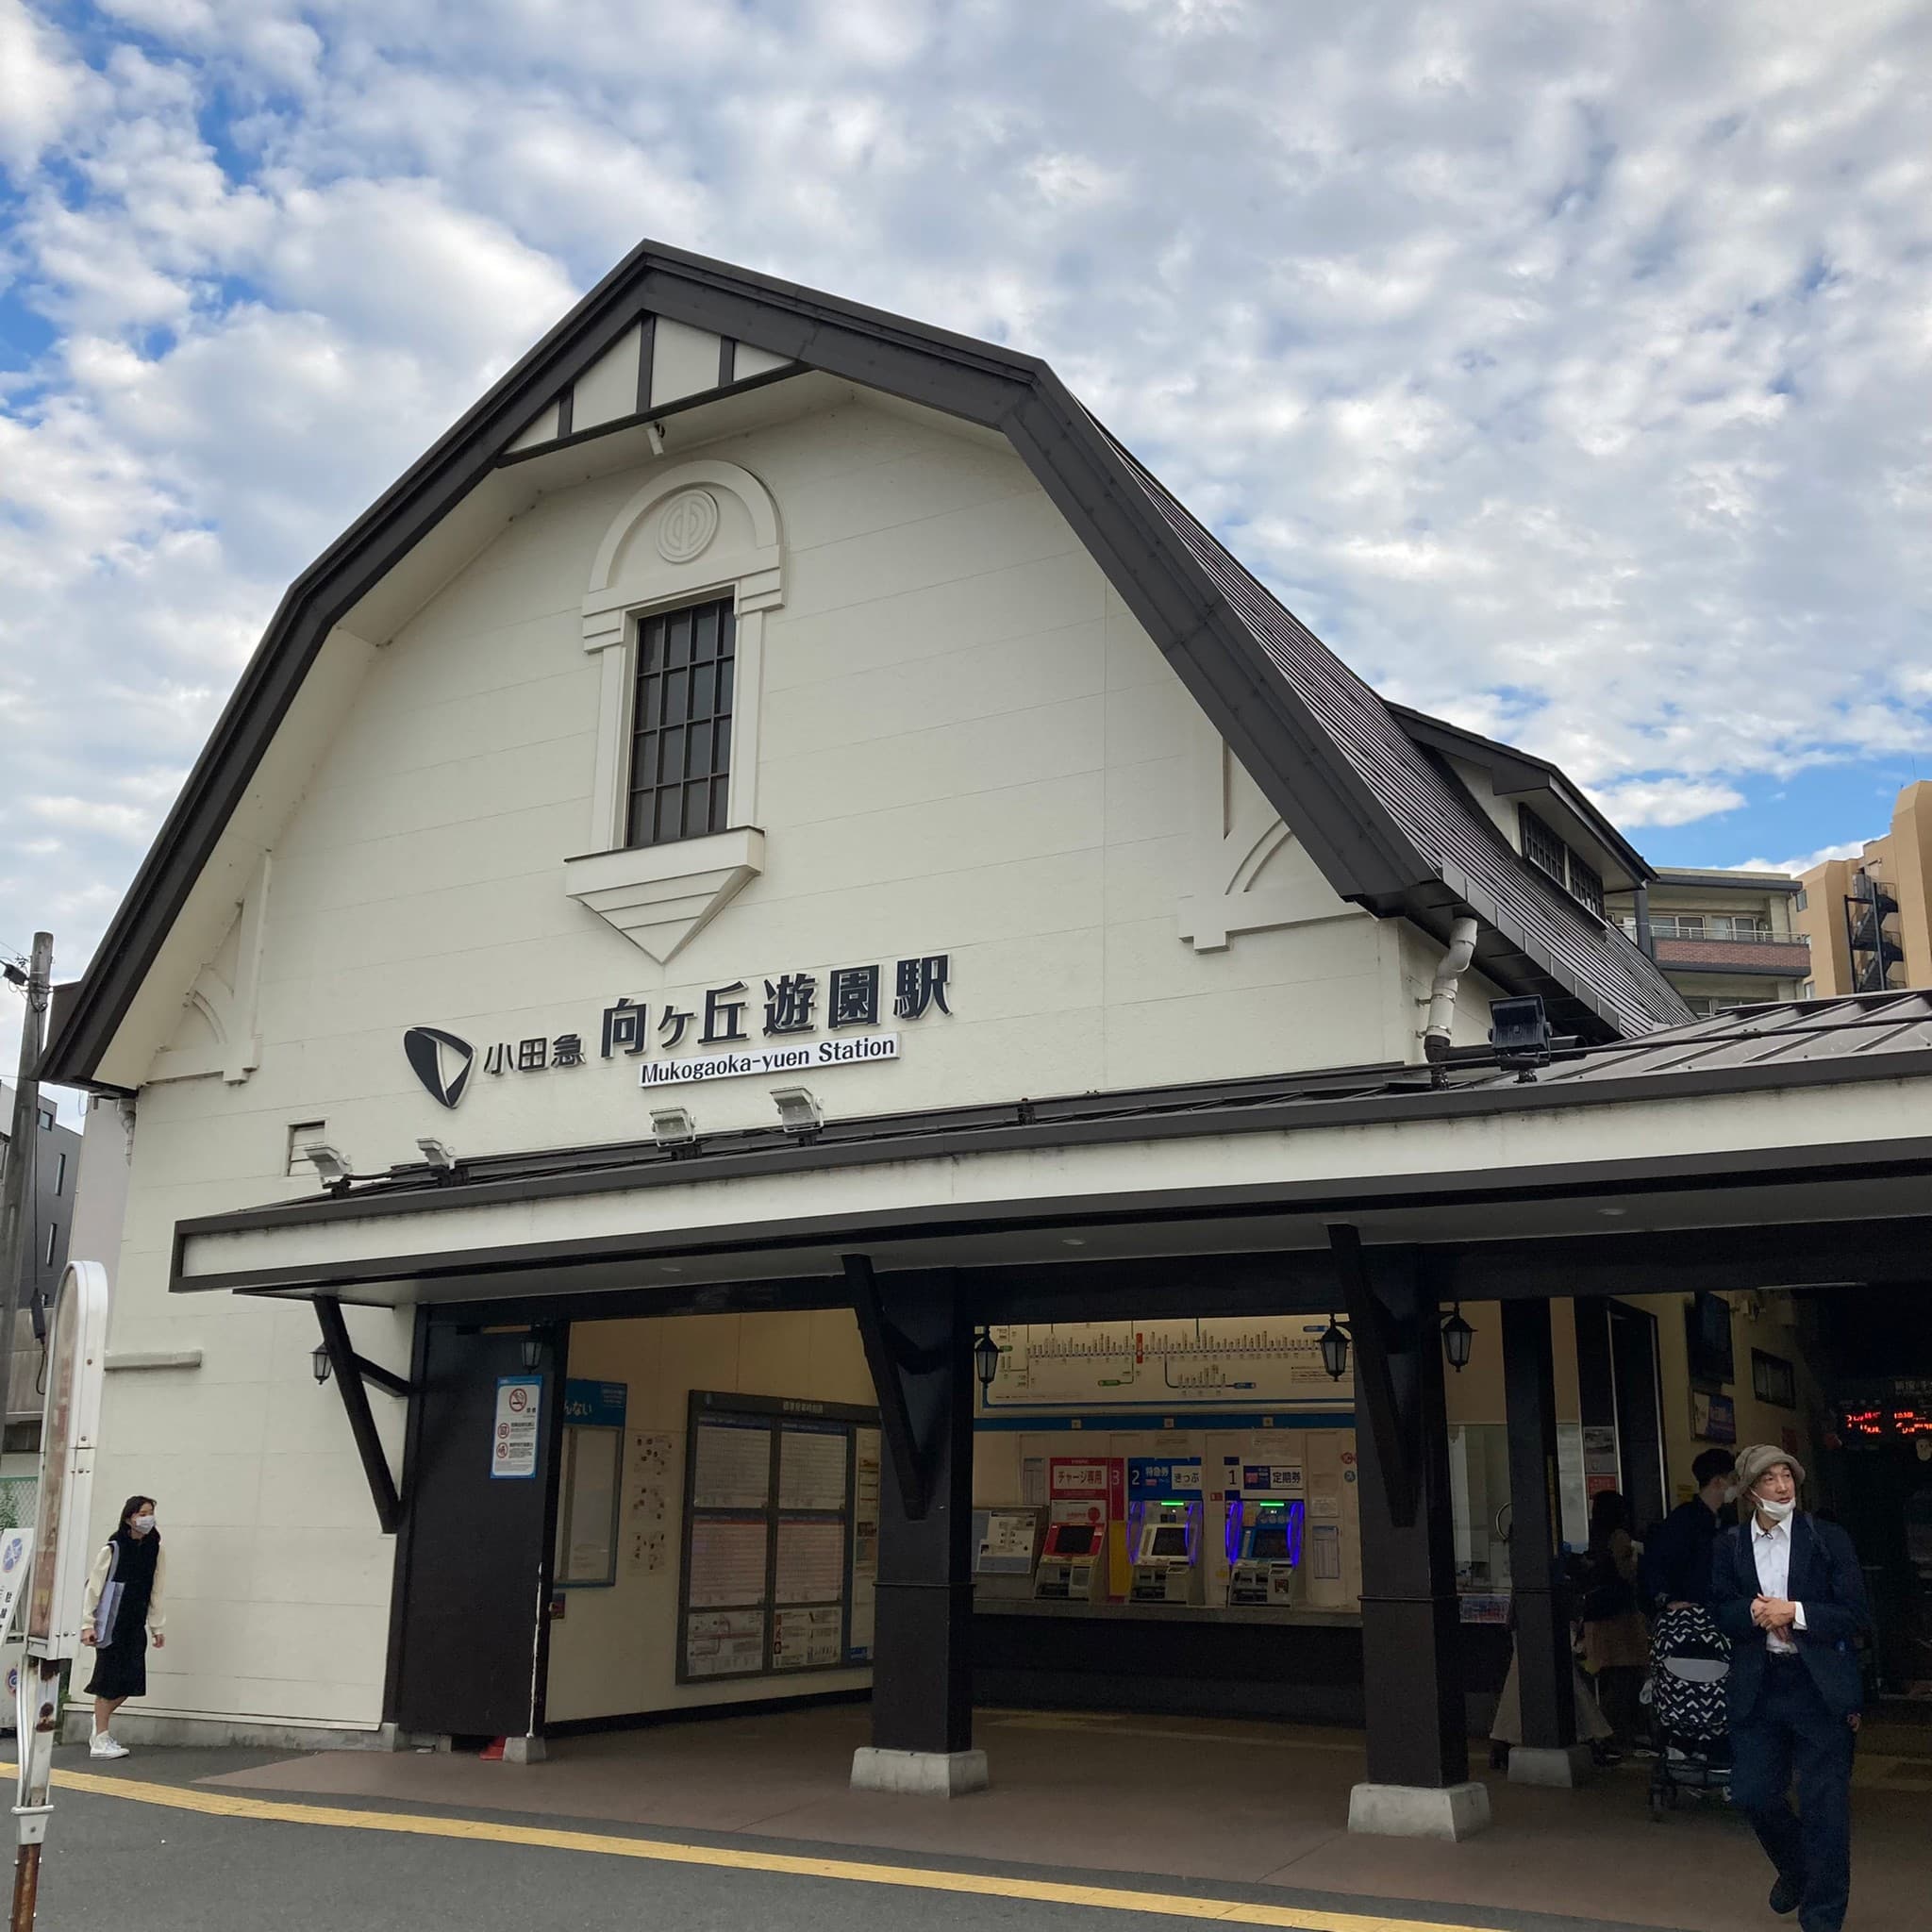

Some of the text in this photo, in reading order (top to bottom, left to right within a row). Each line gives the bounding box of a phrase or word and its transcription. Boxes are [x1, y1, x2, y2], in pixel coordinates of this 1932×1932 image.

[484, 954, 952, 1075] 小田急 向ヶ丘遊園駅
[641, 1040, 895, 1084] Mukogaoka-yuen Station
[1111, 1470, 1120, 1485] 3
[1131, 1470, 1141, 1486] 2
[1228, 1470, 1237, 1485] 1
[1273, 1472, 1301, 1484] 定期券
